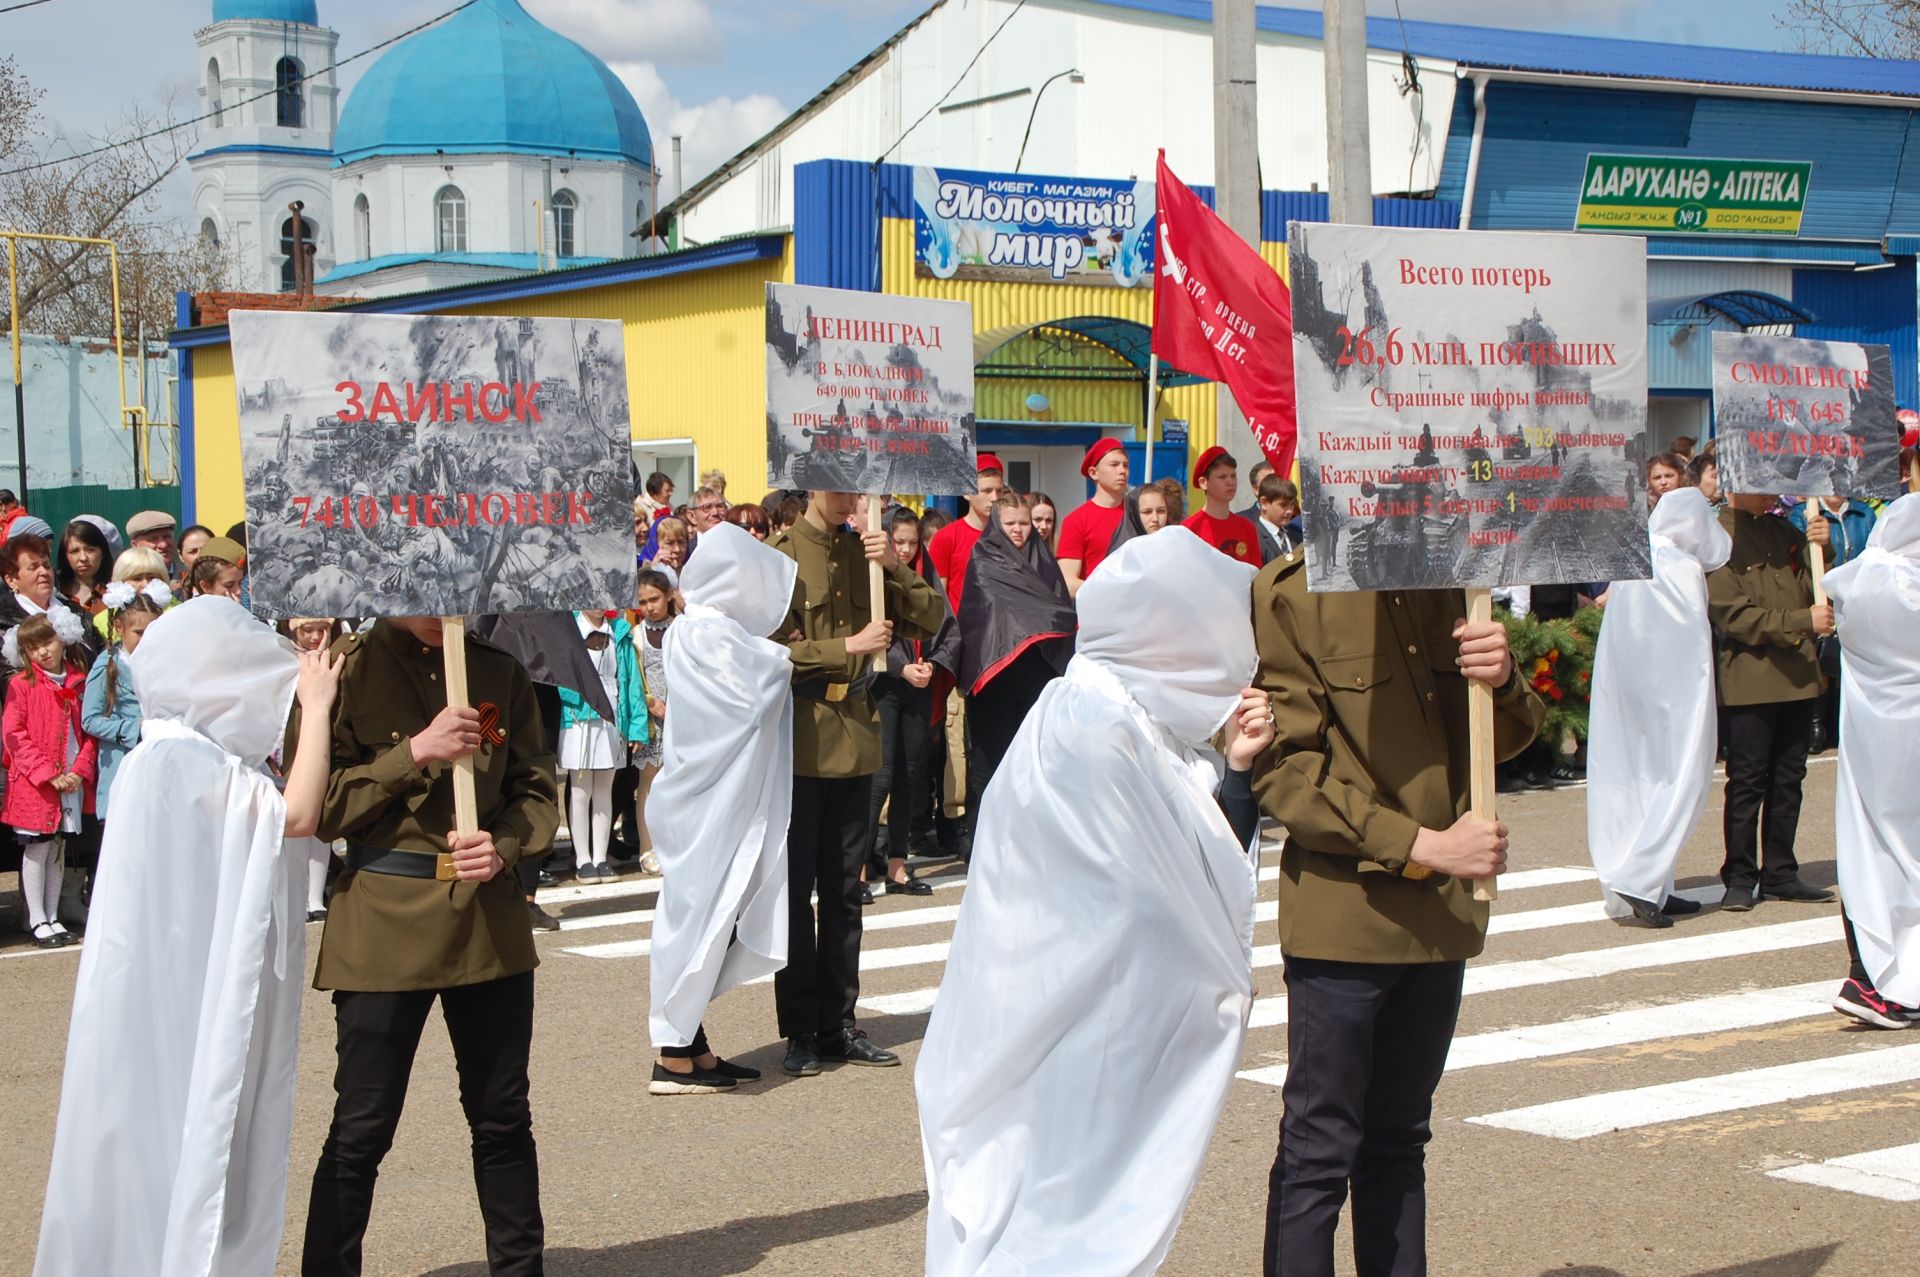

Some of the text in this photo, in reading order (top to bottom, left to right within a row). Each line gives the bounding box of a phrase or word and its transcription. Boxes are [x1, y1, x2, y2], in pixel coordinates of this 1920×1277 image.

[1043, 184, 1112, 198] МАГАЗИН
[1586, 165, 1800, 202] ДАРУХАНӘ АПТЕКА
[936, 182, 1135, 229] Молочный
[1677, 209, 1702, 226] №1
[989, 232, 1083, 279] мир
[1399, 257, 1552, 294] Всего потерь
[803, 316, 943, 351] ЛЕНИНГРАД
[1336, 326, 1404, 375] 26,6
[818, 361, 827, 376] В
[1730, 360, 1871, 392] СМОЛЕНСК
[334, 380, 543, 425] ЗАИНСК
[816, 383, 929, 404] 649 000 ЧЕЛОВЕК
[1370, 387, 1589, 414] Страшные цифры войны
[792, 412, 822, 430] ПРИ
[1809, 400, 1845, 423] 645
[1318, 431, 1392, 454] Каждый
[1398, 435, 1424, 451] час
[1523, 426, 1553, 448] 793
[1555, 431, 1627, 449] человека
[1749, 430, 1867, 458] ЧЕЛОВЕК
[1320, 464, 1392, 486] Каждую
[1471, 459, 1493, 481] 13
[1495, 465, 1562, 481] человек
[292, 490, 592, 530] 7410 ЧЕЛОВЕК
[1348, 496, 1419, 518] Каждые
[1423, 494, 1433, 515] 5
[1507, 490, 1516, 513] 1
